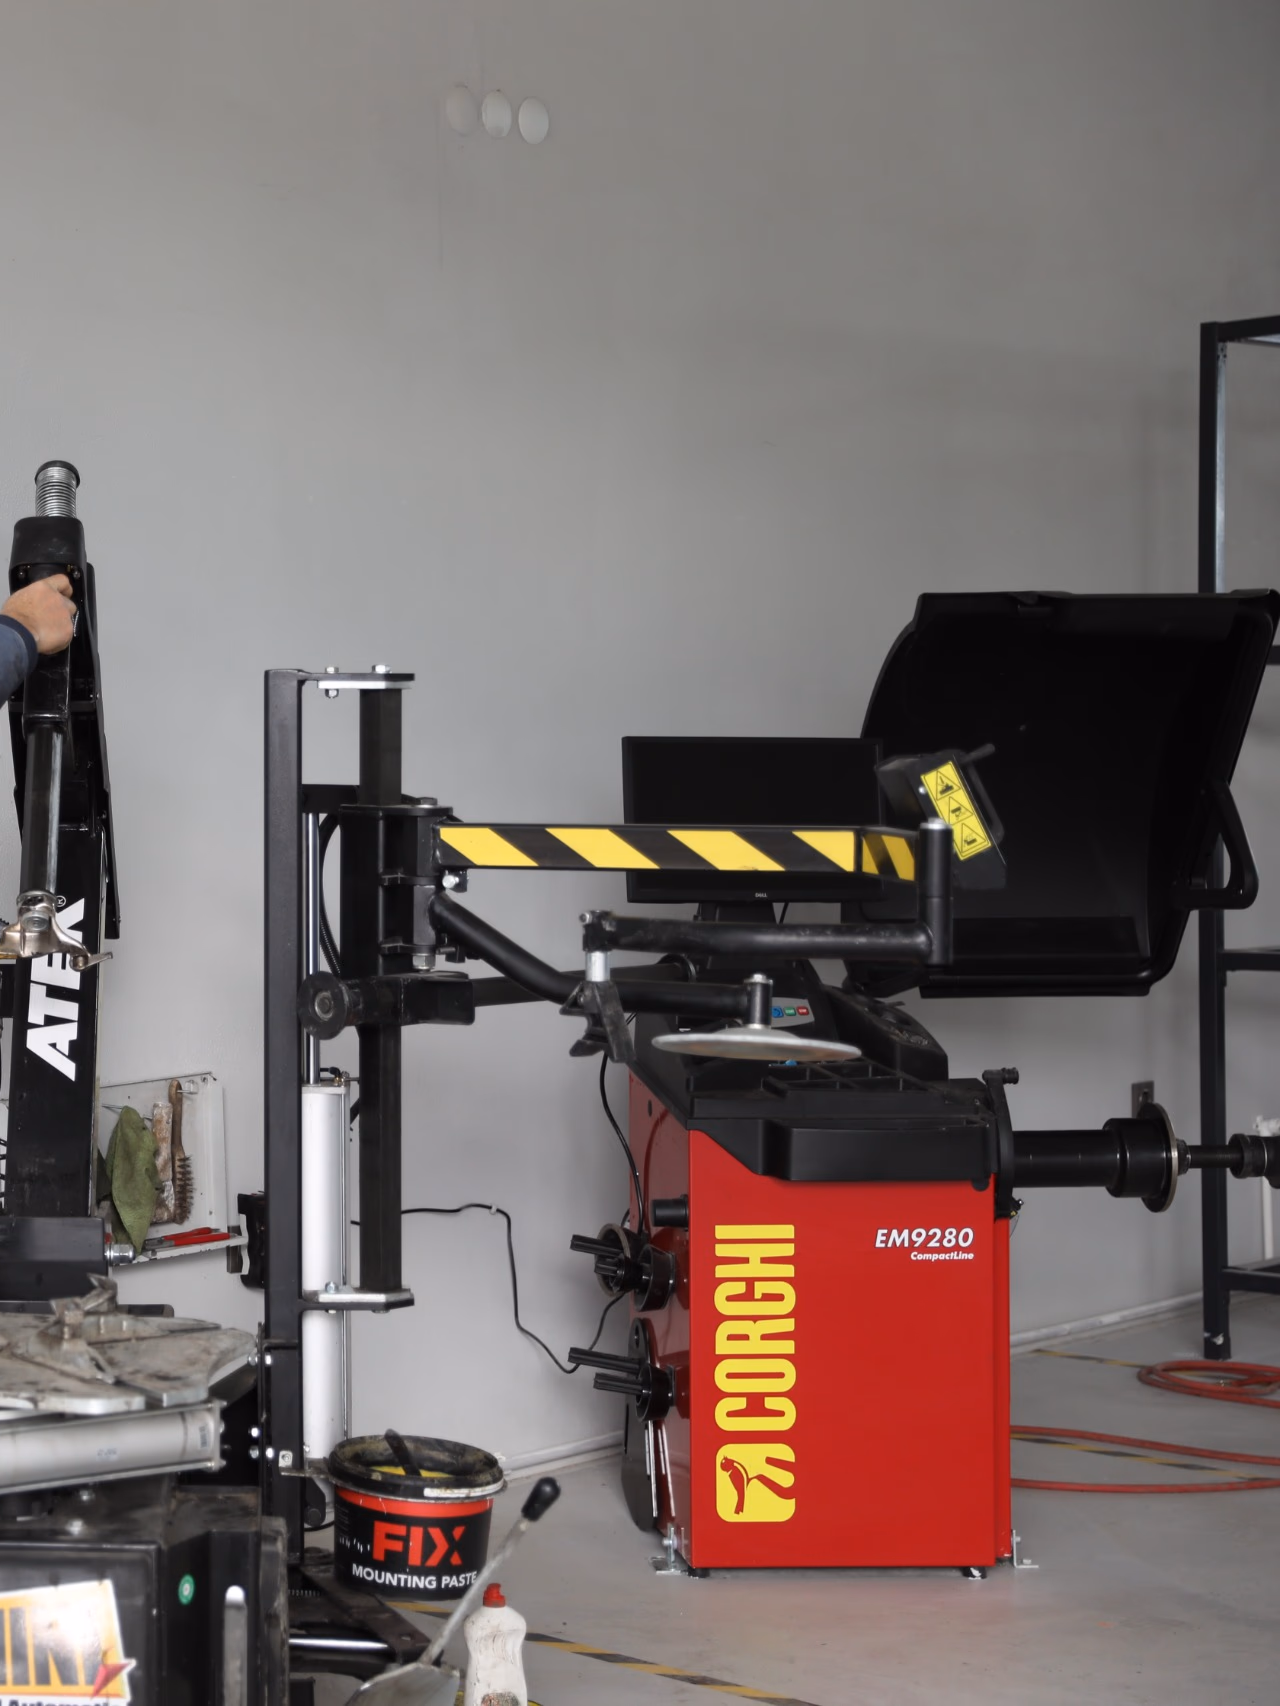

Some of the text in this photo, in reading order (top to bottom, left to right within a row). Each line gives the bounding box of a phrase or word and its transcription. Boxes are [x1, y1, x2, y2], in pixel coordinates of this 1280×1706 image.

[875, 1228, 974, 1247] EM9280
[910, 1251, 974, 1261] CompactLine
[714, 1224, 797, 1431] CORGHI
[372, 1520, 466, 1567] FIX
[352, 1563, 477, 1589] MOUNTING PASTE
